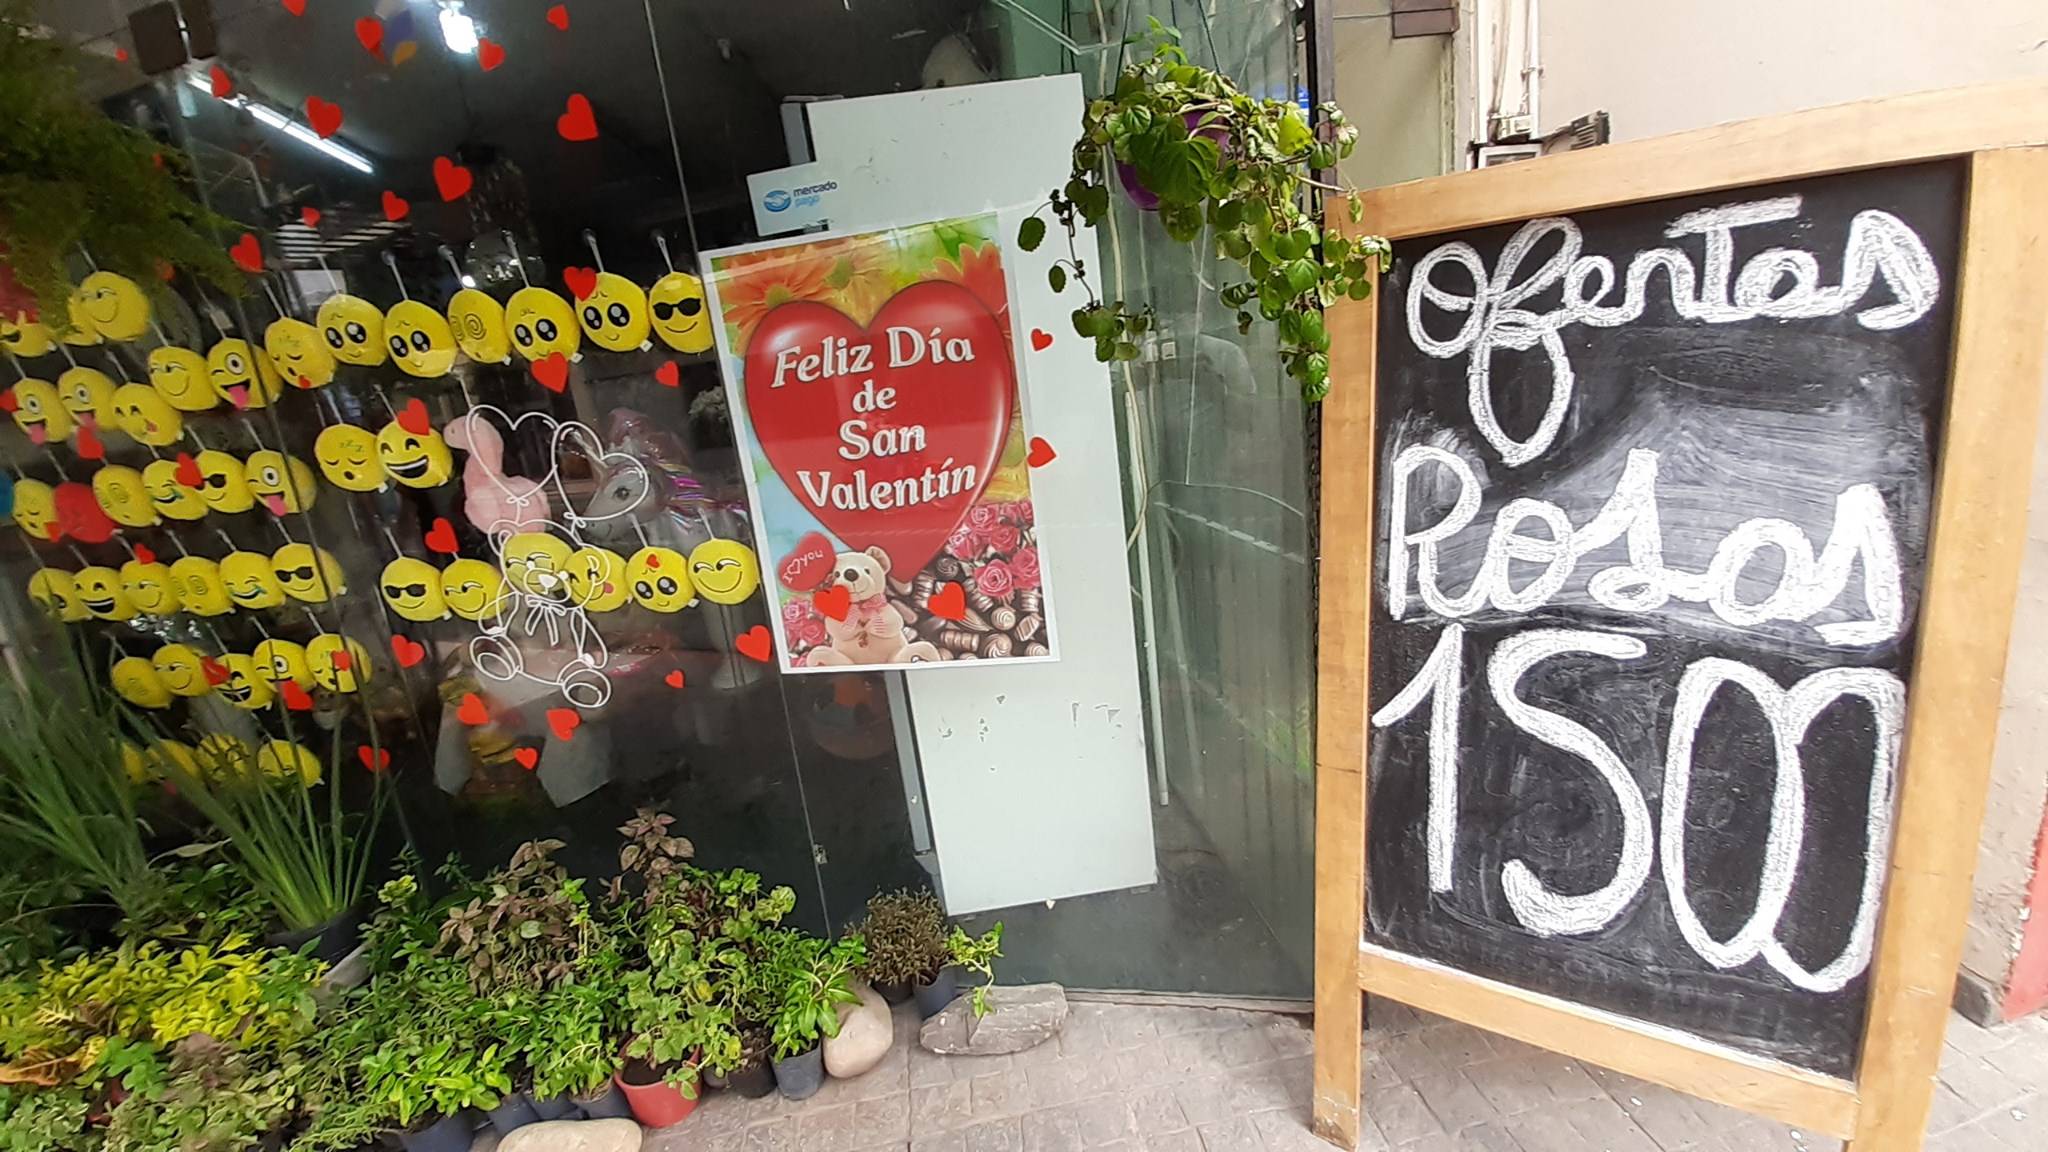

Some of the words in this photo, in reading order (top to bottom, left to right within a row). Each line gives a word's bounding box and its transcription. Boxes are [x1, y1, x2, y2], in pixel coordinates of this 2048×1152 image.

[793, 181, 838, 197] mercado
[771, 336, 874, 388] Feliz
[886, 326, 975, 368] Día
[852, 379, 897, 413] de
[838, 419, 926, 460] San
[796, 457, 976, 511] Valentín
[1372, 623, 1906, 993] 1500
